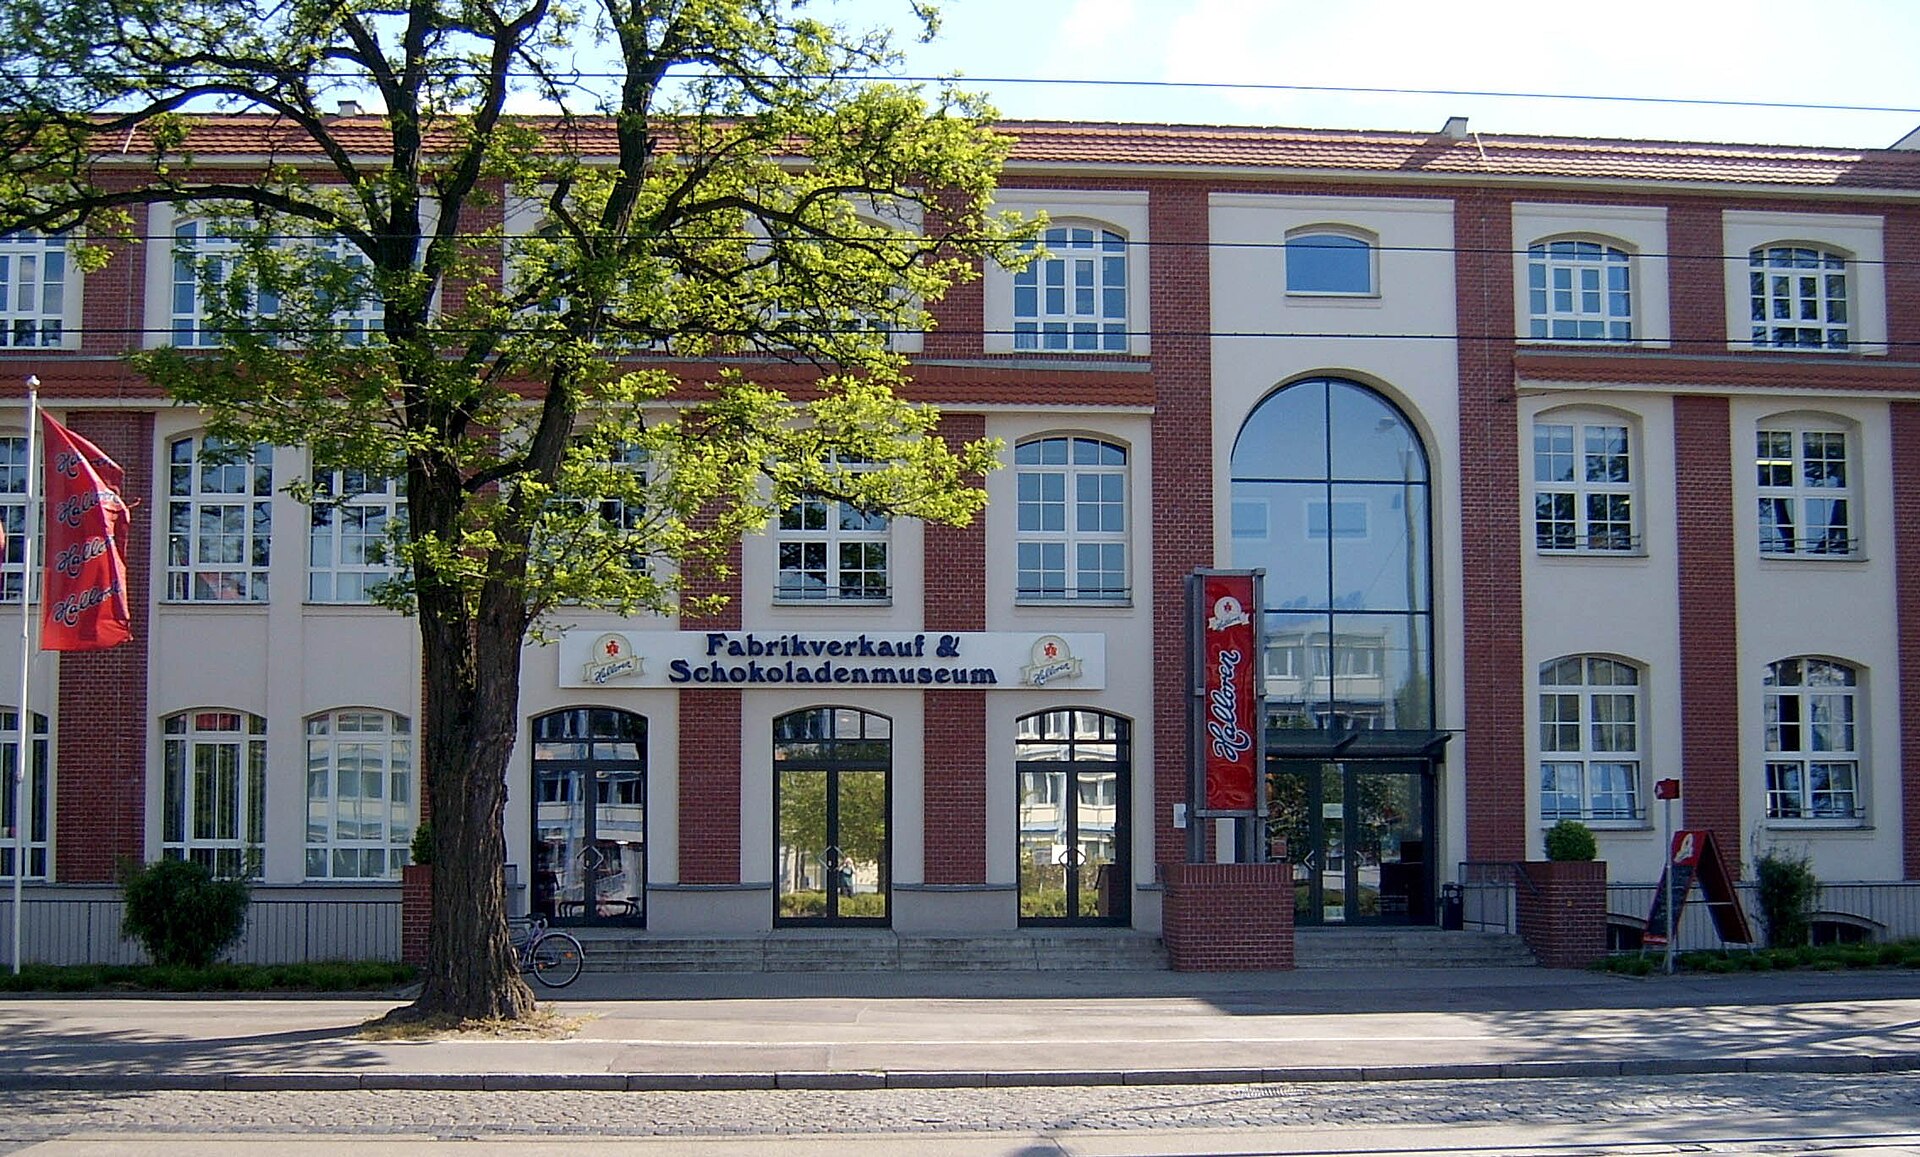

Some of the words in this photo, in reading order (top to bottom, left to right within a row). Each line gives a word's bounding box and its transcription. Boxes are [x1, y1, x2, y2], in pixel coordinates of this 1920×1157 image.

[706, 633, 926, 657] Fabrikverkauf
[936, 635, 960, 658] &
[668, 659, 998, 684] Schokoladenmuseum
[1208, 649, 1251, 763] Halloren
